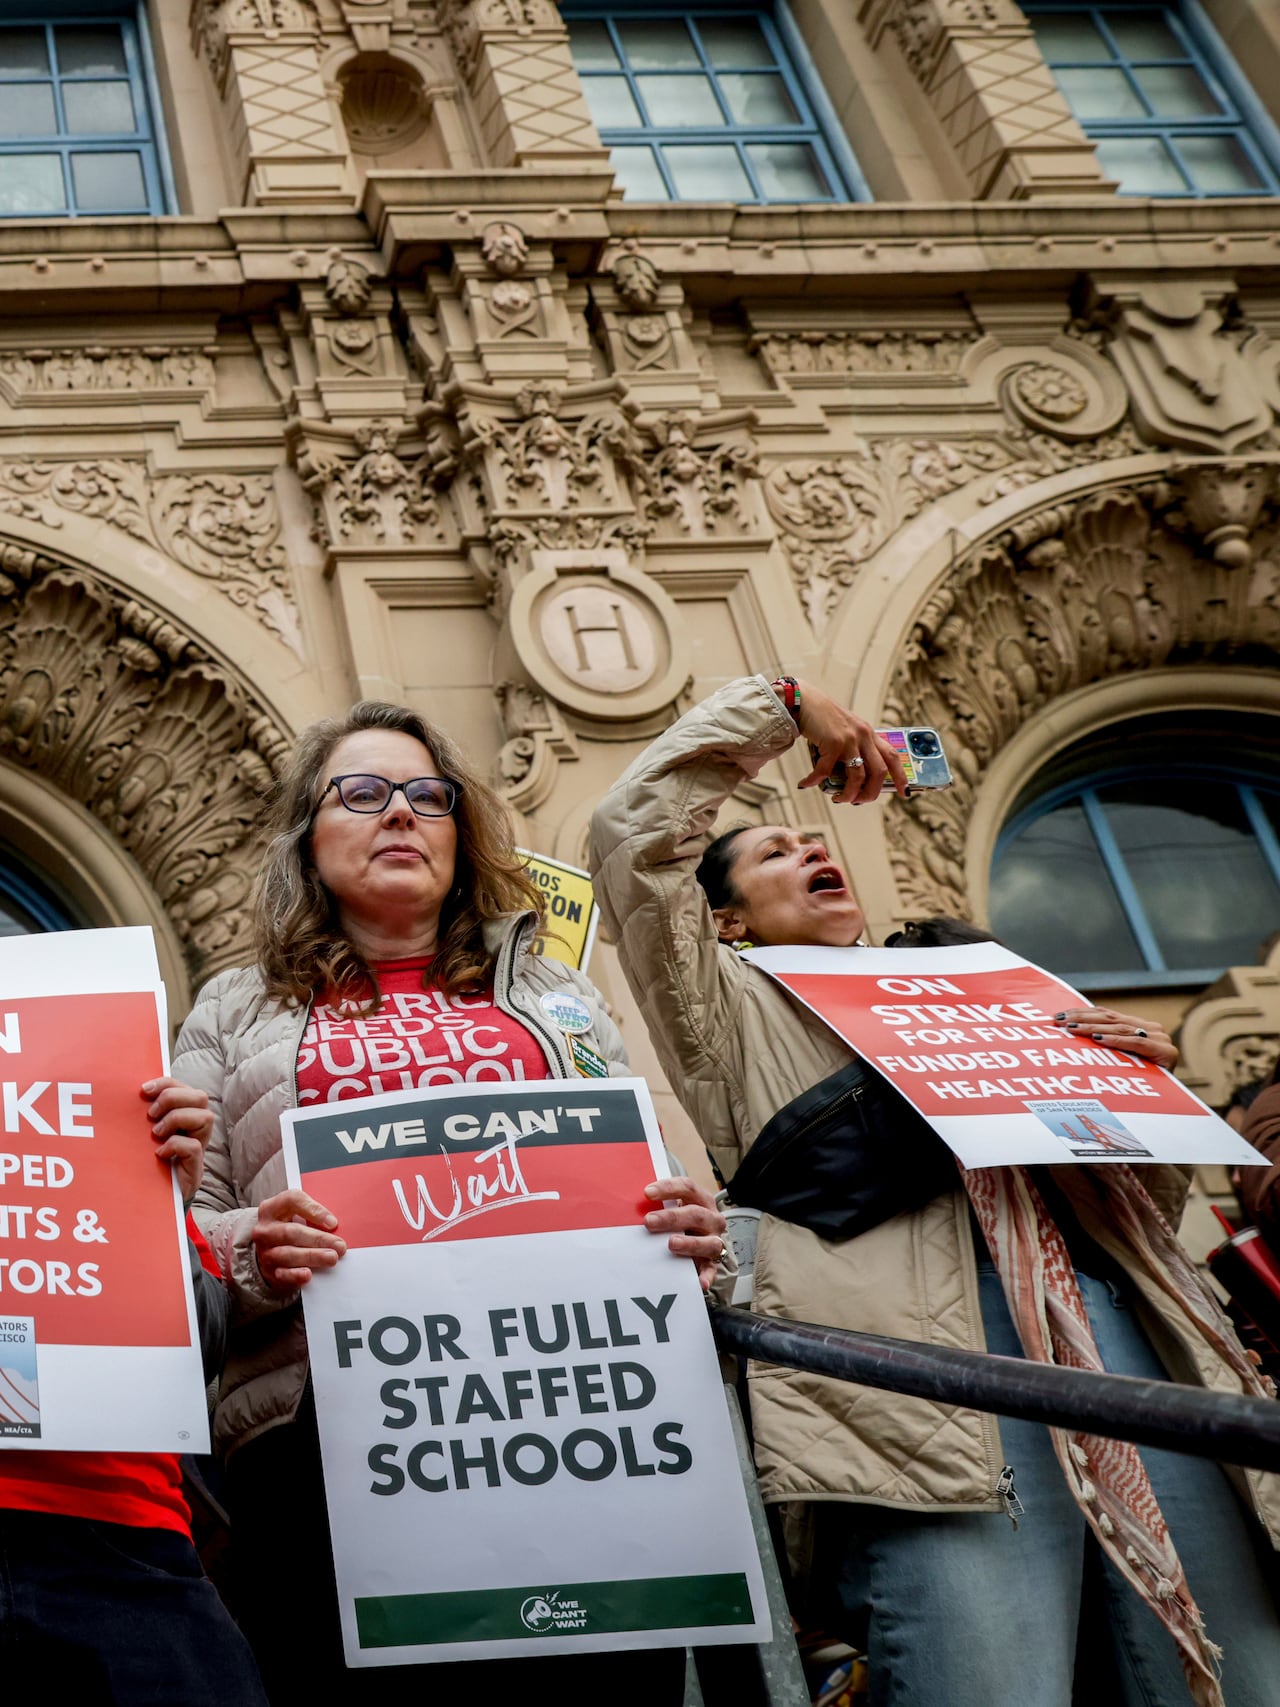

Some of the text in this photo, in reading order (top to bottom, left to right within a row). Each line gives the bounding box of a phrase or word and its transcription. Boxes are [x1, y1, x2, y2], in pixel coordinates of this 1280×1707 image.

[564, 605, 639, 671] H
[876, 977, 967, 997] ON
[558, 1019, 583, 1028] OPEN
[870, 1002, 1054, 1025] STRIKE
[895, 1025, 1076, 1047] FOR FULLY
[876, 1048, 1147, 1073] FUNDED FAMILY
[925, 1075, 1161, 1099] HEALTHCARE
[334, 1106, 601, 1153] WE CAN'T
[392, 1124, 547, 1231] Wait
[73, 1209, 110, 1244] &
[332, 1293, 678, 1369] FOR FULLY
[379, 1360, 657, 1429] STAFFED
[367, 1421, 693, 1496] SCHOOLS
[557, 1600, 579, 1609] WE
[555, 1619, 587, 1628] WAIT
